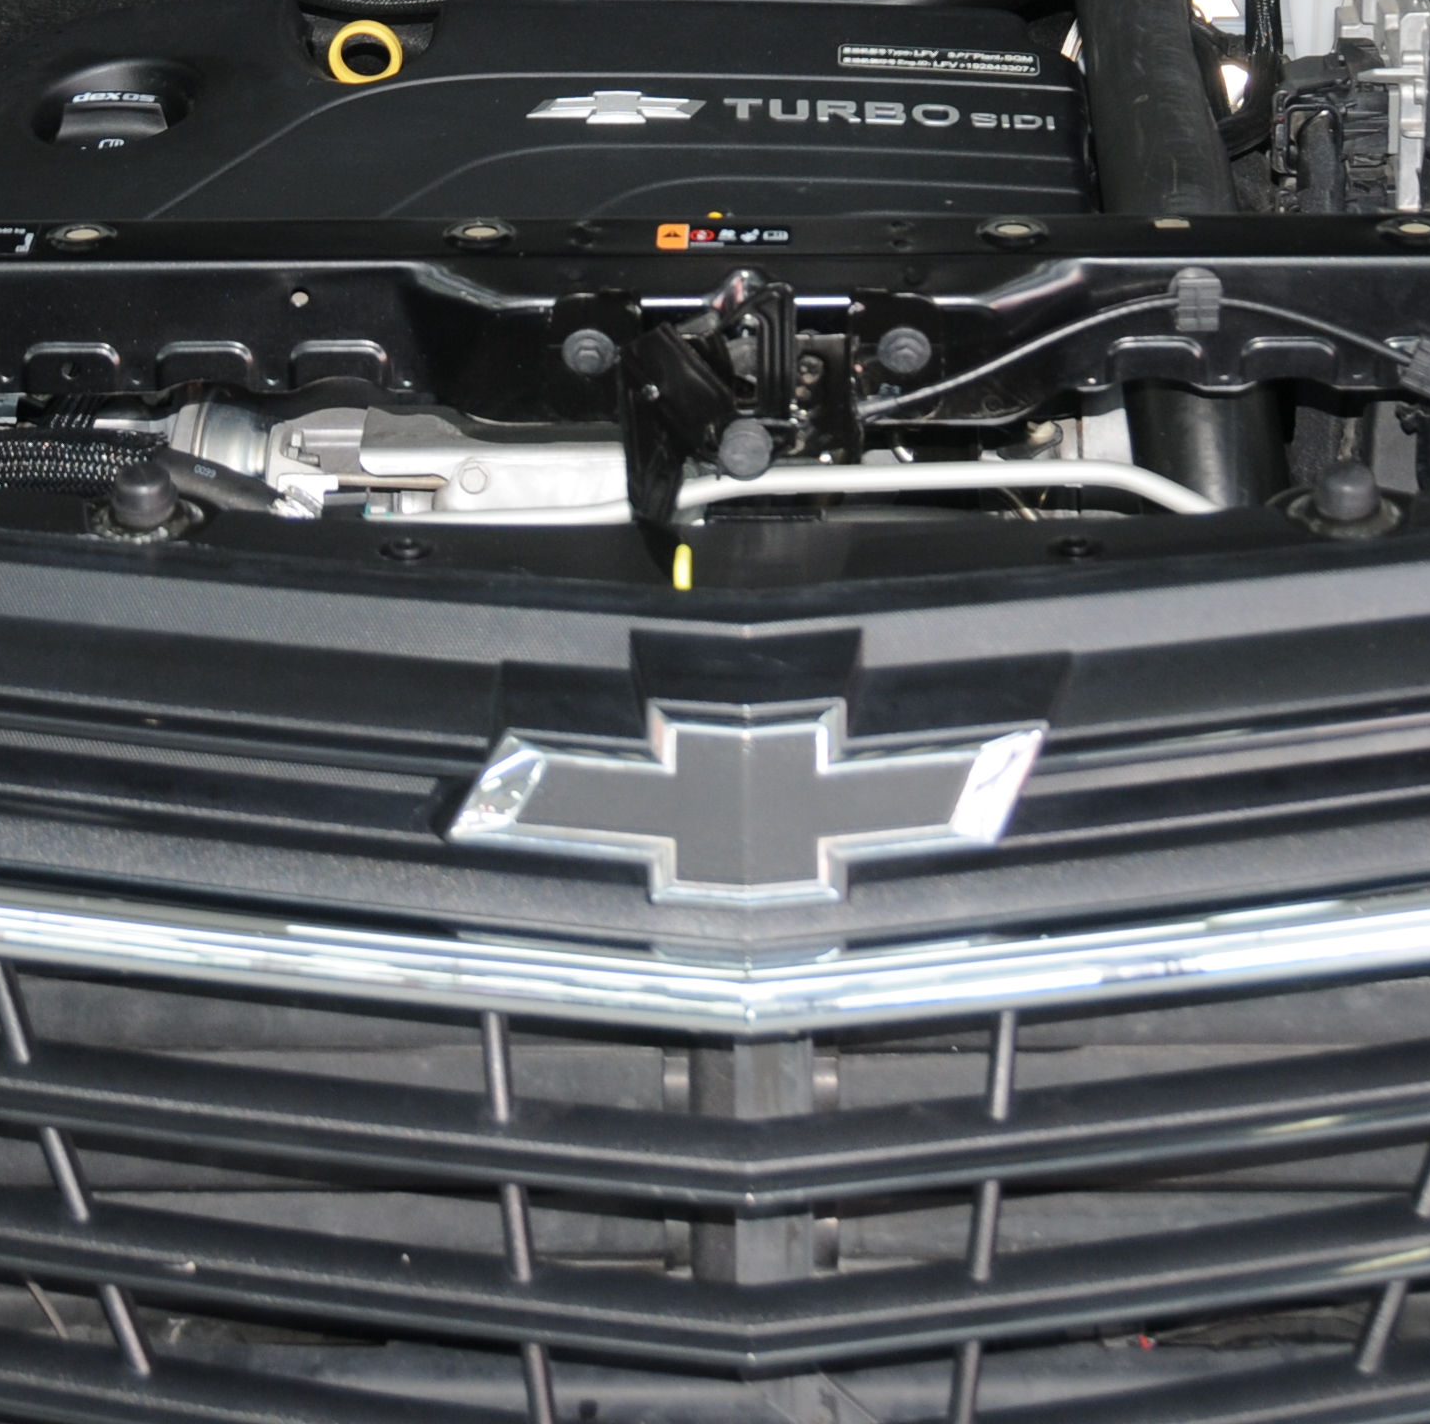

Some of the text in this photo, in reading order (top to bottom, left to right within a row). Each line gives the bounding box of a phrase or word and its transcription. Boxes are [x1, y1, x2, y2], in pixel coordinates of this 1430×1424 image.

[72, 92, 157, 104] dexos
[723, 97, 1056, 131] TURBO SIDI
